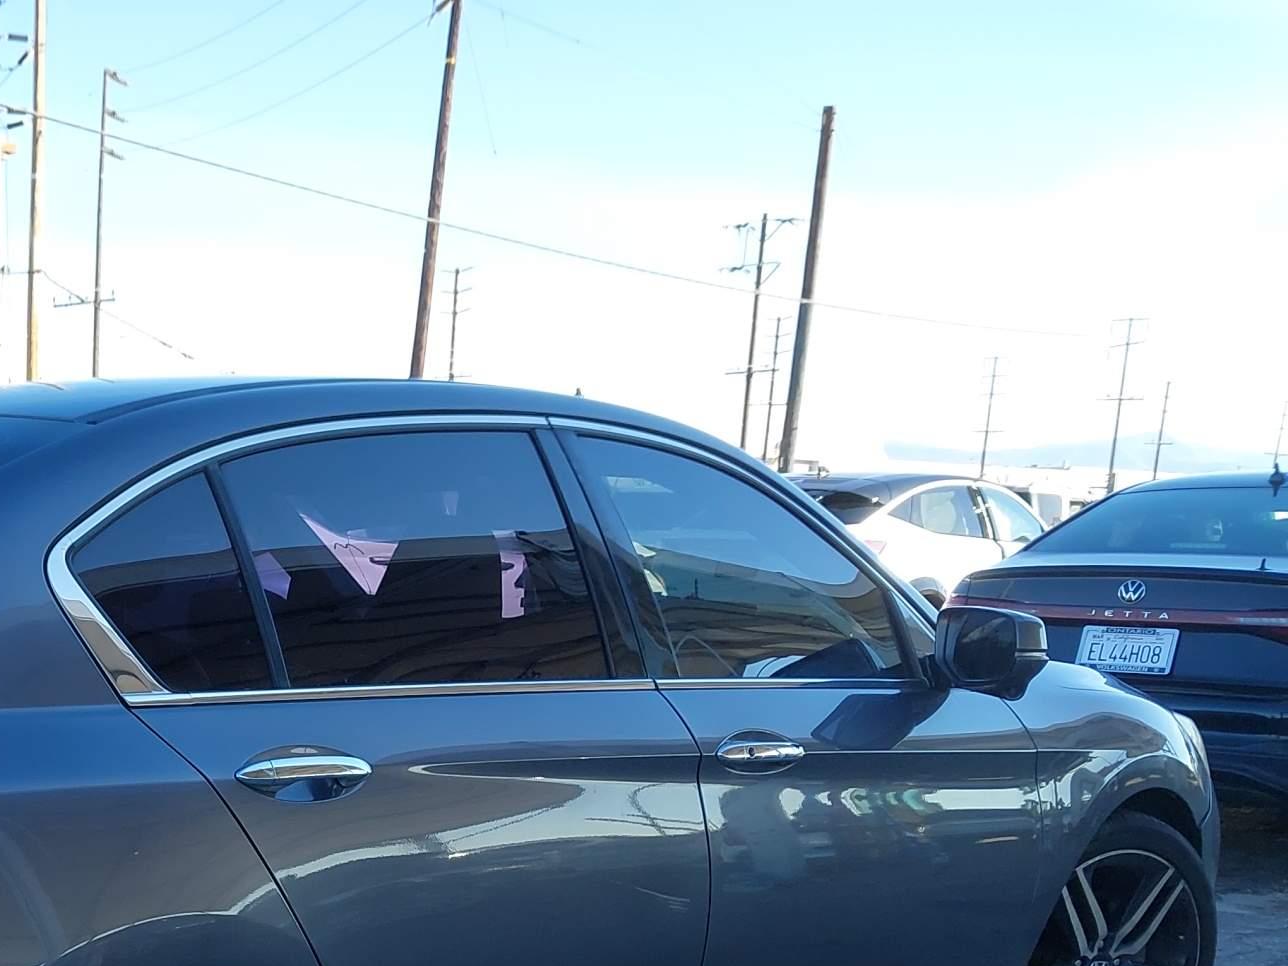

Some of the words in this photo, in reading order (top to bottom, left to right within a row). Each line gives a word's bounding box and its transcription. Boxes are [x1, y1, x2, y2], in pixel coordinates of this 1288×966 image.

[1088, 609, 1169, 620] JETTA
[1107, 627, 1155, 635] ONTARIO
[1087, 642, 1162, 665] EL44H08
